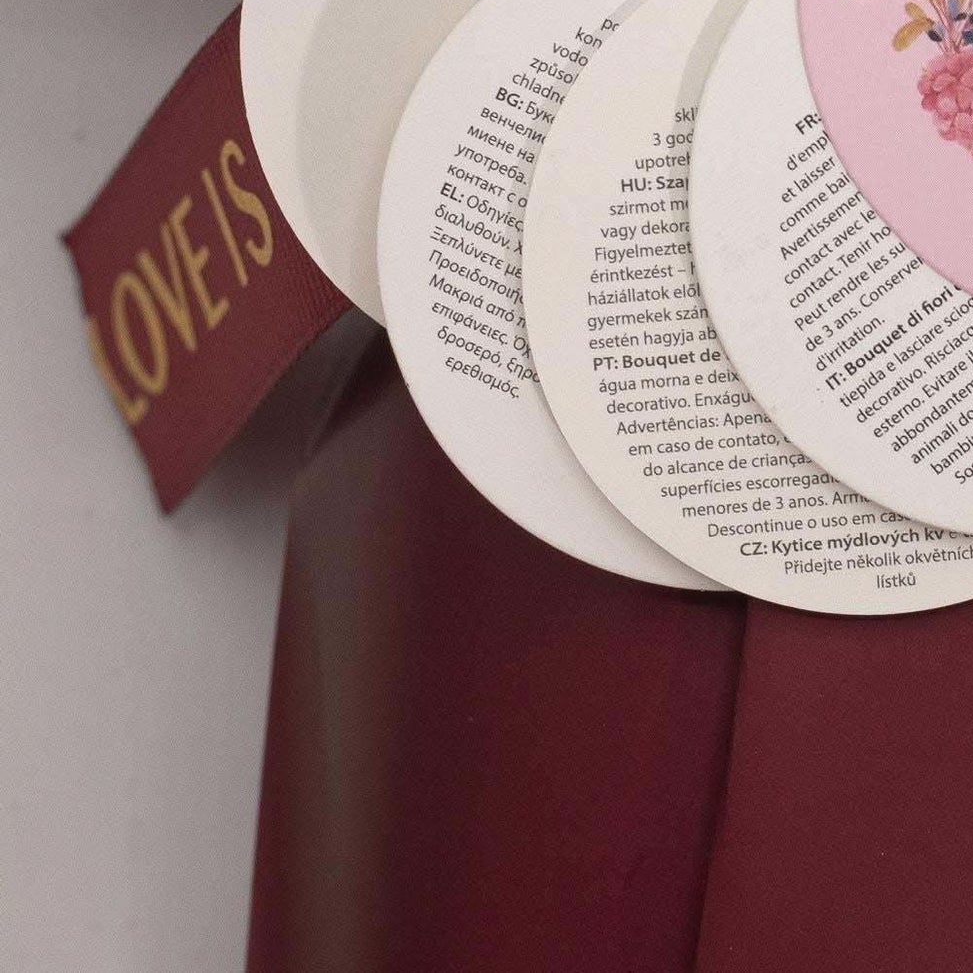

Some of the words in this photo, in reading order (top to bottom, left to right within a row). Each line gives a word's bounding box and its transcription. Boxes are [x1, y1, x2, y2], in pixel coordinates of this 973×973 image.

[574, 26, 603, 50] kon
[552, 42, 589, 68] vodo
[494, 86, 525, 111] BG:
[466, 125, 515, 155] миене
[652, 132, 662, 147] 3
[453, 143, 527, 186] употреба.
[439, 181, 465, 204] EL:
[446, 163, 507, 198] контакт
[620, 176, 653, 194] HU:
[781, 186, 798, 204] et
[792, 155, 836, 193] laisser
[201, 139, 273, 287] IS
[609, 198, 667, 217] szirmot
[779, 191, 829, 233] comme
[599, 225, 638, 242] vagy
[429, 225, 505, 271] Ξεπλύνετε
[783, 242, 834, 286] contact
[832, 219, 864, 248] avec
[589, 263, 674, 284] érintkezést
[789, 266, 842, 309] contact.
[835, 238, 873, 269] Tenir
[428, 273, 485, 310] Μακριά
[485, 302, 515, 323] από
[587, 285, 671, 307] háziállatok
[793, 302, 829, 332] Peut
[826, 270, 871, 308] rendre
[866, 254, 890, 275] les
[586, 307, 673, 332] gyermekek
[804, 334, 825, 353] de
[821, 324, 834, 339] 3
[833, 306, 862, 331] ans.
[588, 332, 640, 350] esetén
[643, 328, 695, 348] hagyja
[815, 317, 886, 372] d'irritation.
[824, 371, 848, 392] IT:
[843, 323, 909, 377] Bouquet
[906, 308, 924, 328] di
[921, 285, 955, 316] fiori
[592, 355, 619, 372] PT:
[621, 350, 696, 370] Bouquet
[699, 345, 722, 363] de
[839, 369, 887, 408] tiepida
[885, 360, 897, 373] e
[892, 323, 945, 365] lasciare
[444, 356, 520, 400] ερεθισμός.
[598, 378, 637, 396] água
[640, 375, 691, 390] morna
[693, 374, 704, 386] e
[606, 395, 692, 415] decorativo.
[856, 368, 928, 424] decorativo.
[872, 397, 926, 439] esterno.
[921, 360, 969, 399] Evitare
[616, 414, 720, 436] Advertências:
[628, 444, 653, 457] em
[656, 440, 691, 454] caso
[694, 435, 715, 451] de
[717, 432, 781, 450] contato,
[910, 420, 959, 465] animali
[642, 461, 664, 478] do
[667, 459, 725, 476] alcance
[727, 454, 748, 471] de
[660, 478, 743, 500] superfícies
[681, 501, 749, 518] menores
[751, 496, 772, 513] de
[775, 495, 785, 511] 3
[787, 495, 829, 510] anos.
[707, 518, 804, 538] Descontinue
[806, 517, 818, 530] o
[820, 515, 849, 529] uso
[851, 513, 877, 526] em
[739, 541, 769, 557] CZ:
[771, 537, 823, 557] Kytice
[826, 527, 920, 553] mýdlových
[784, 557, 844, 576] Přidejte
[846, 550, 903, 570] několik
[876, 571, 917, 590] lístků
